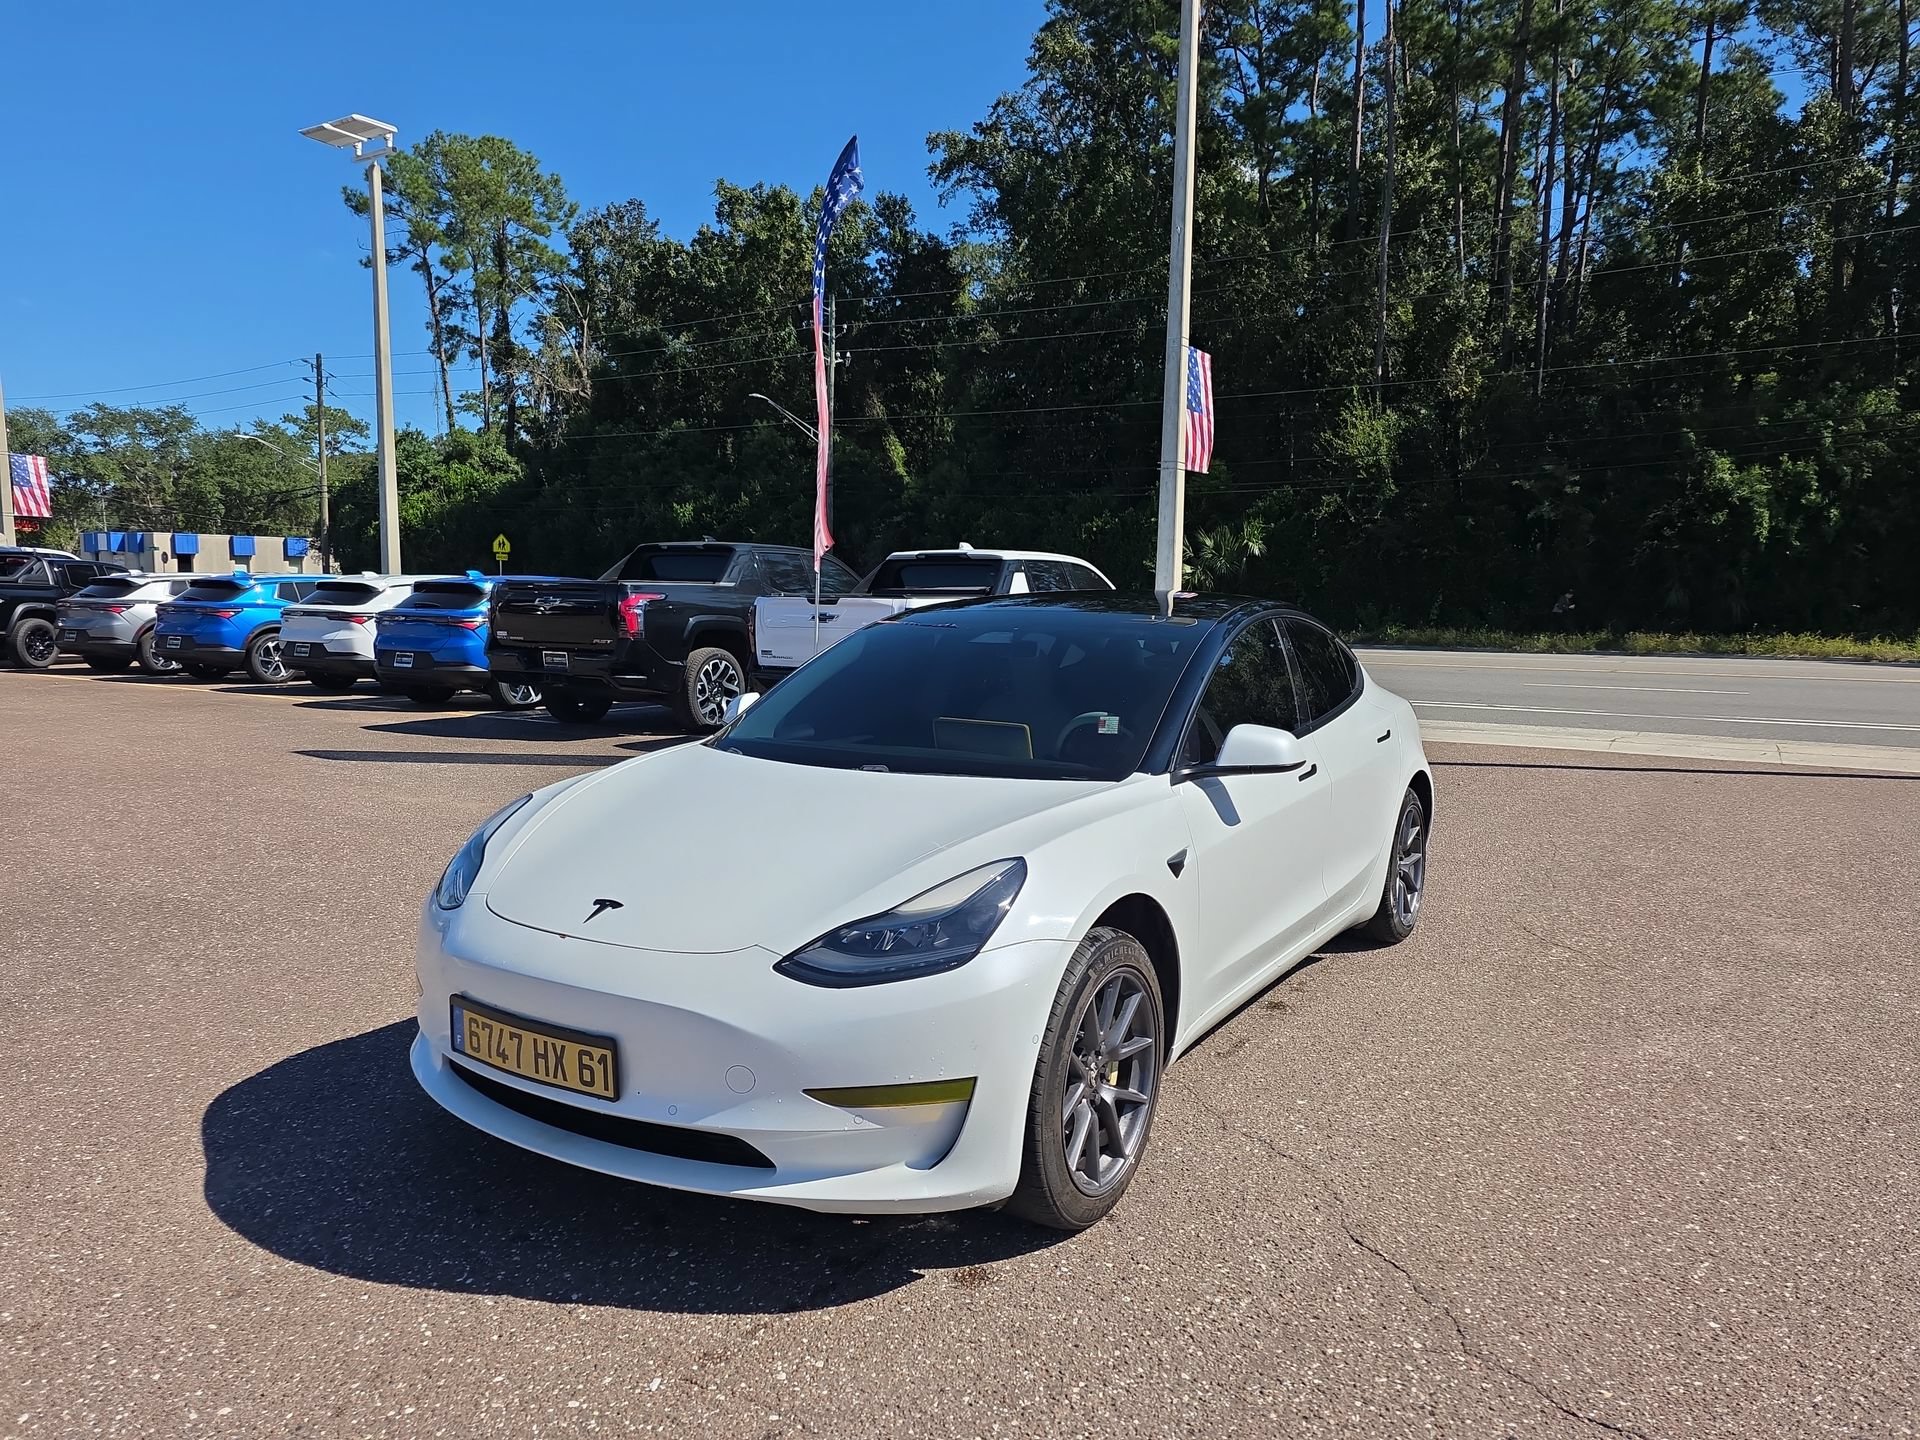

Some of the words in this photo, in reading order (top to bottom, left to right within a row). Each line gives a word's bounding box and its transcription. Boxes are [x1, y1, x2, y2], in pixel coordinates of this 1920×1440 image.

[469, 1017, 523, 1069] 6747
[533, 1038, 568, 1082] HX
[578, 1049, 609, 1092] 61
